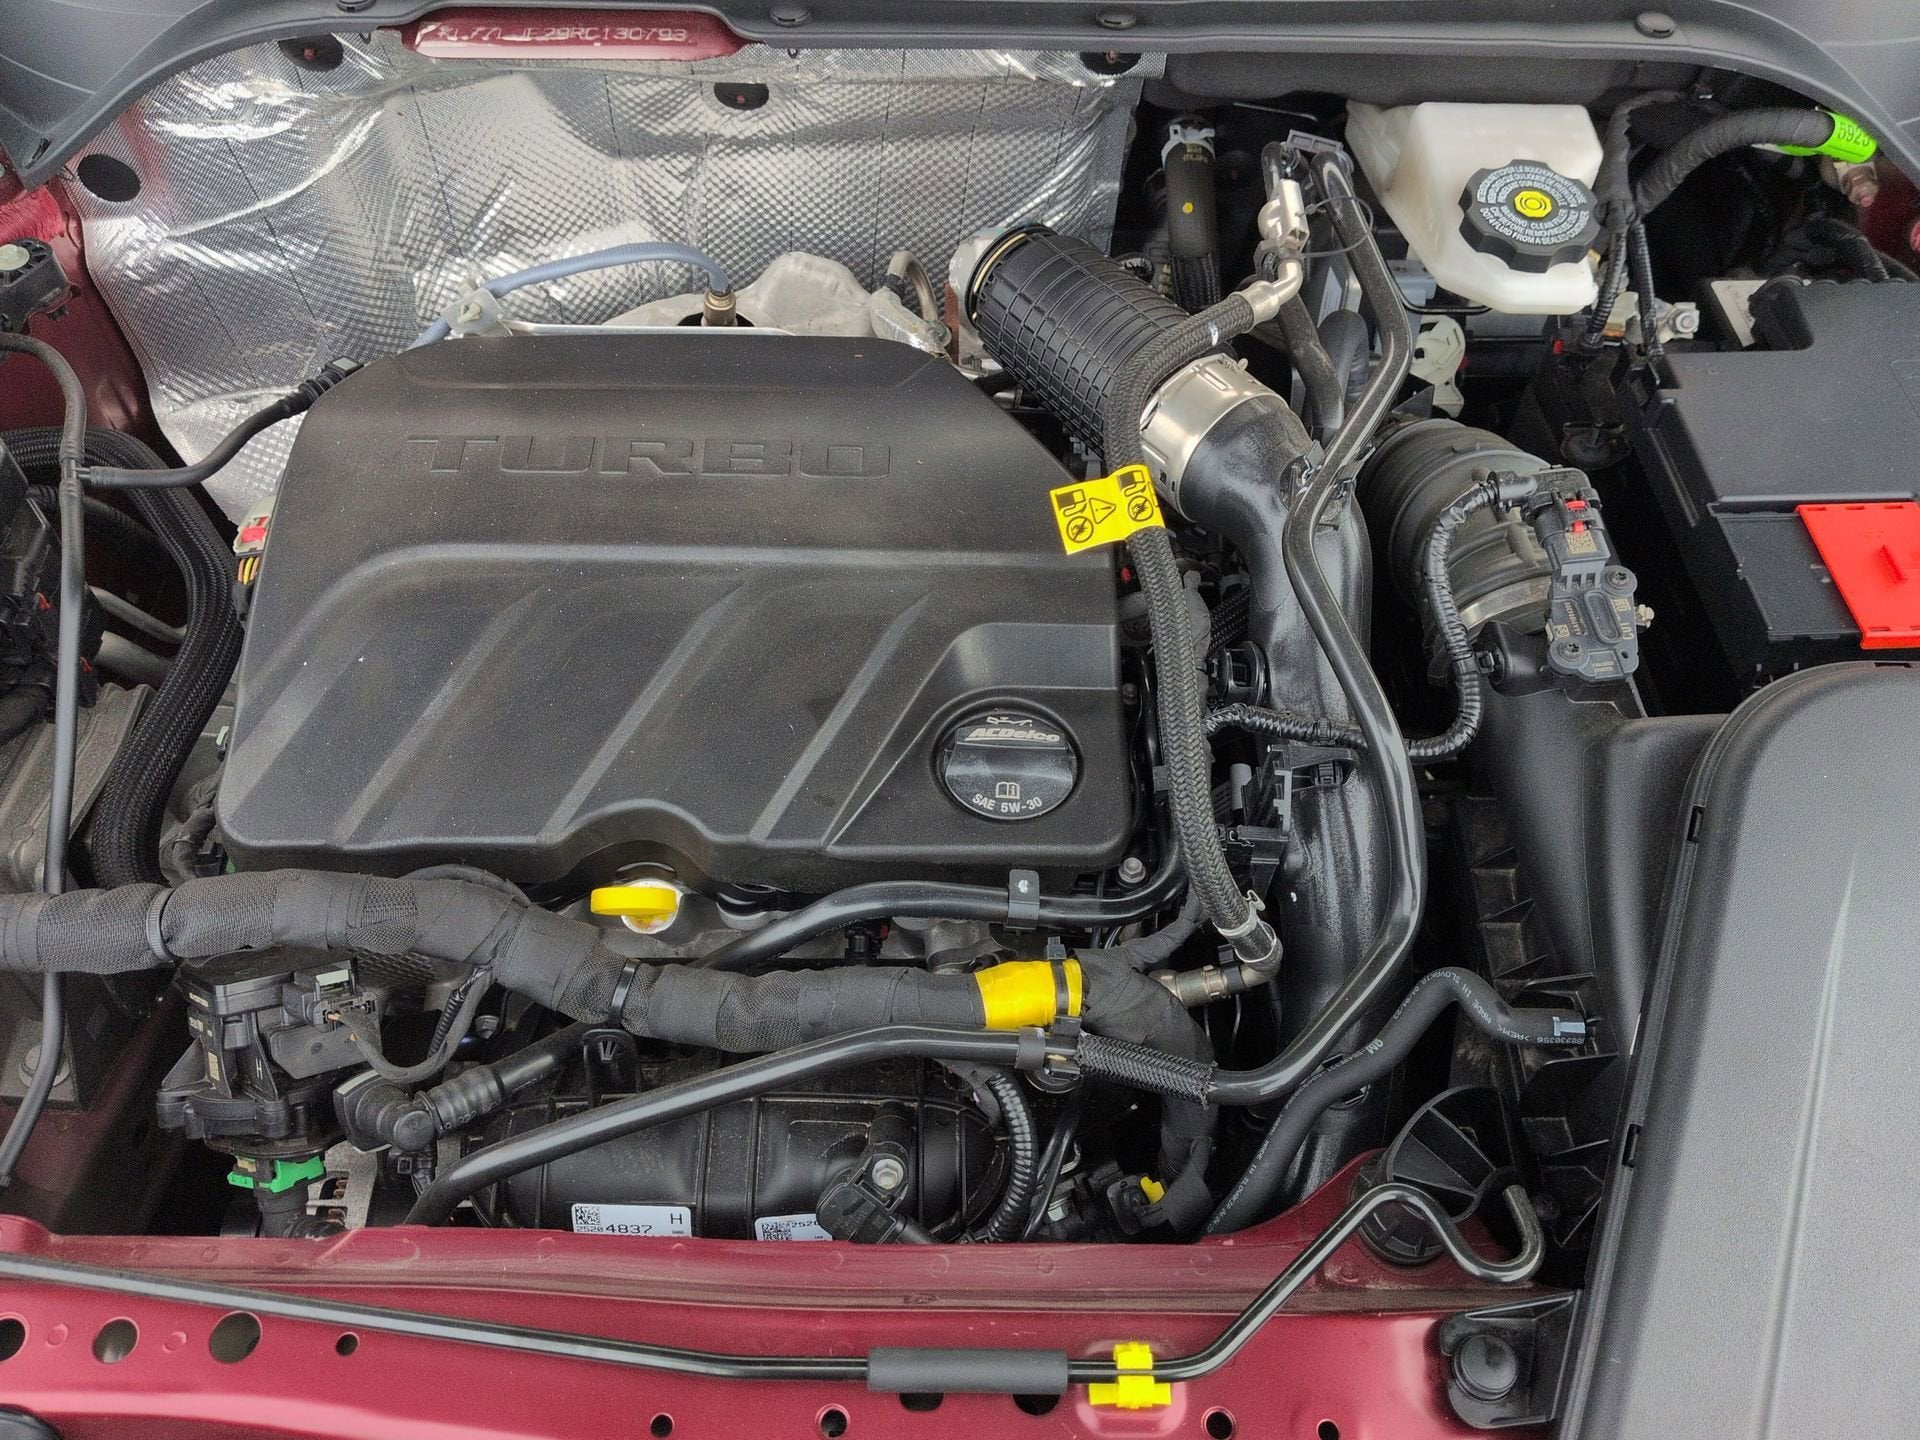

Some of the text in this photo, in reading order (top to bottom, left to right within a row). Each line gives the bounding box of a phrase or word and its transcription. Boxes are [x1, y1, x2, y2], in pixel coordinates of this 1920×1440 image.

[406, 435, 891, 478] TURBO
[965, 727, 1060, 743] ACDelco
[972, 793, 1043, 813] SAE 5W-30
[255, 1057, 263, 1080] H
[669, 1212, 683, 1225] H
[605, 1223, 653, 1234] 4837
